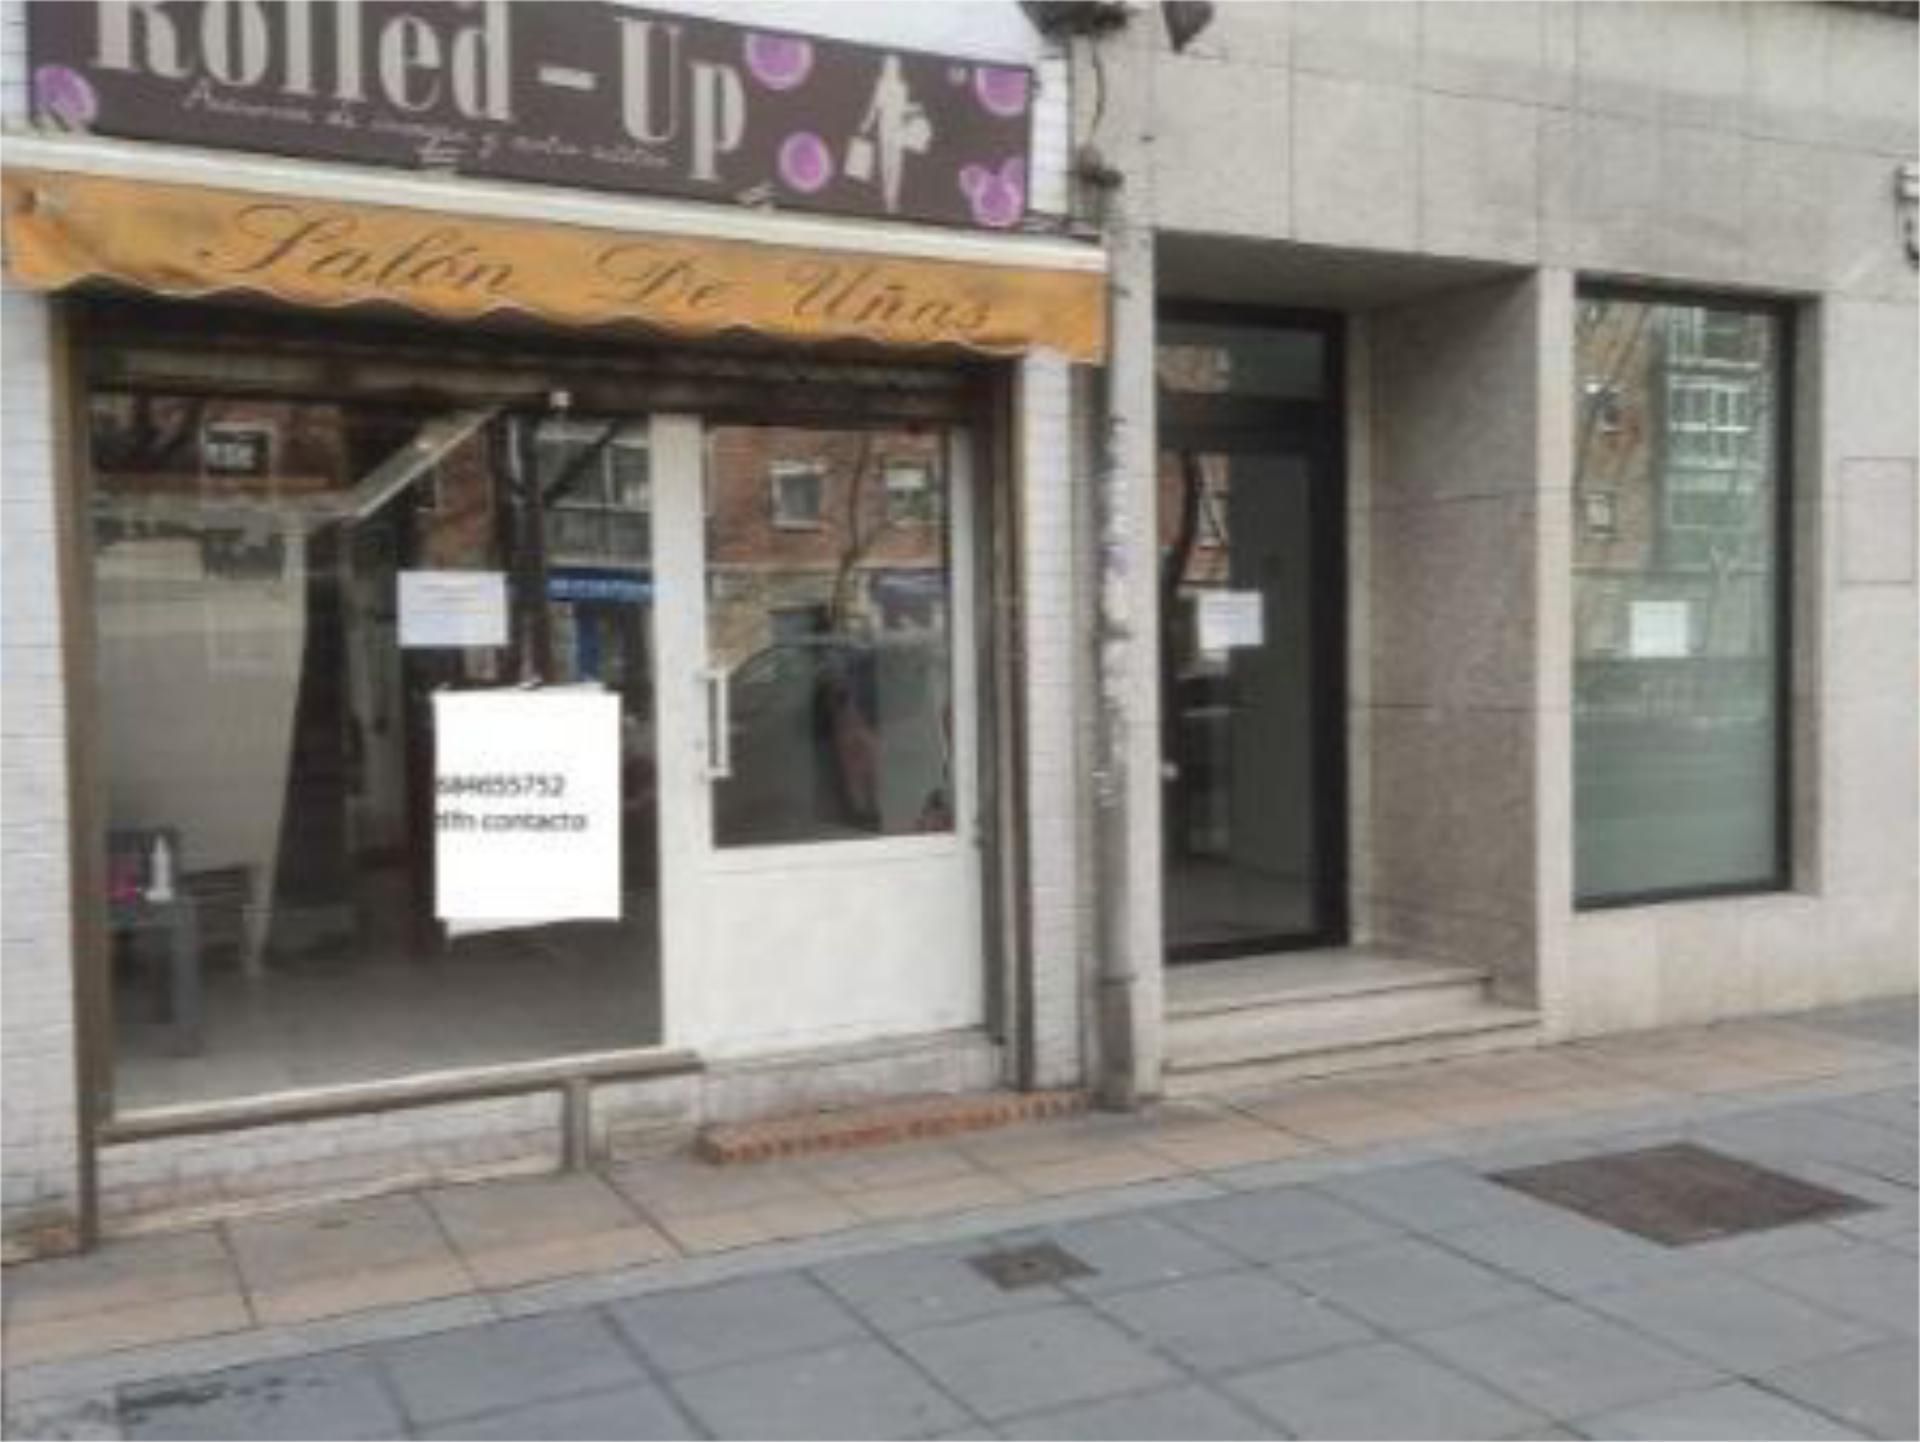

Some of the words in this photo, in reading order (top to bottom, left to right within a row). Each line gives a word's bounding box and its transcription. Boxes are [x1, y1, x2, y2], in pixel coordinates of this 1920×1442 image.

[615, 15, 747, 182] Up
[198, 202, 518, 294] Salón
[586, 241, 735, 310] De
[785, 261, 991, 334] Uñas
[481, 810, 588, 834] contacto
